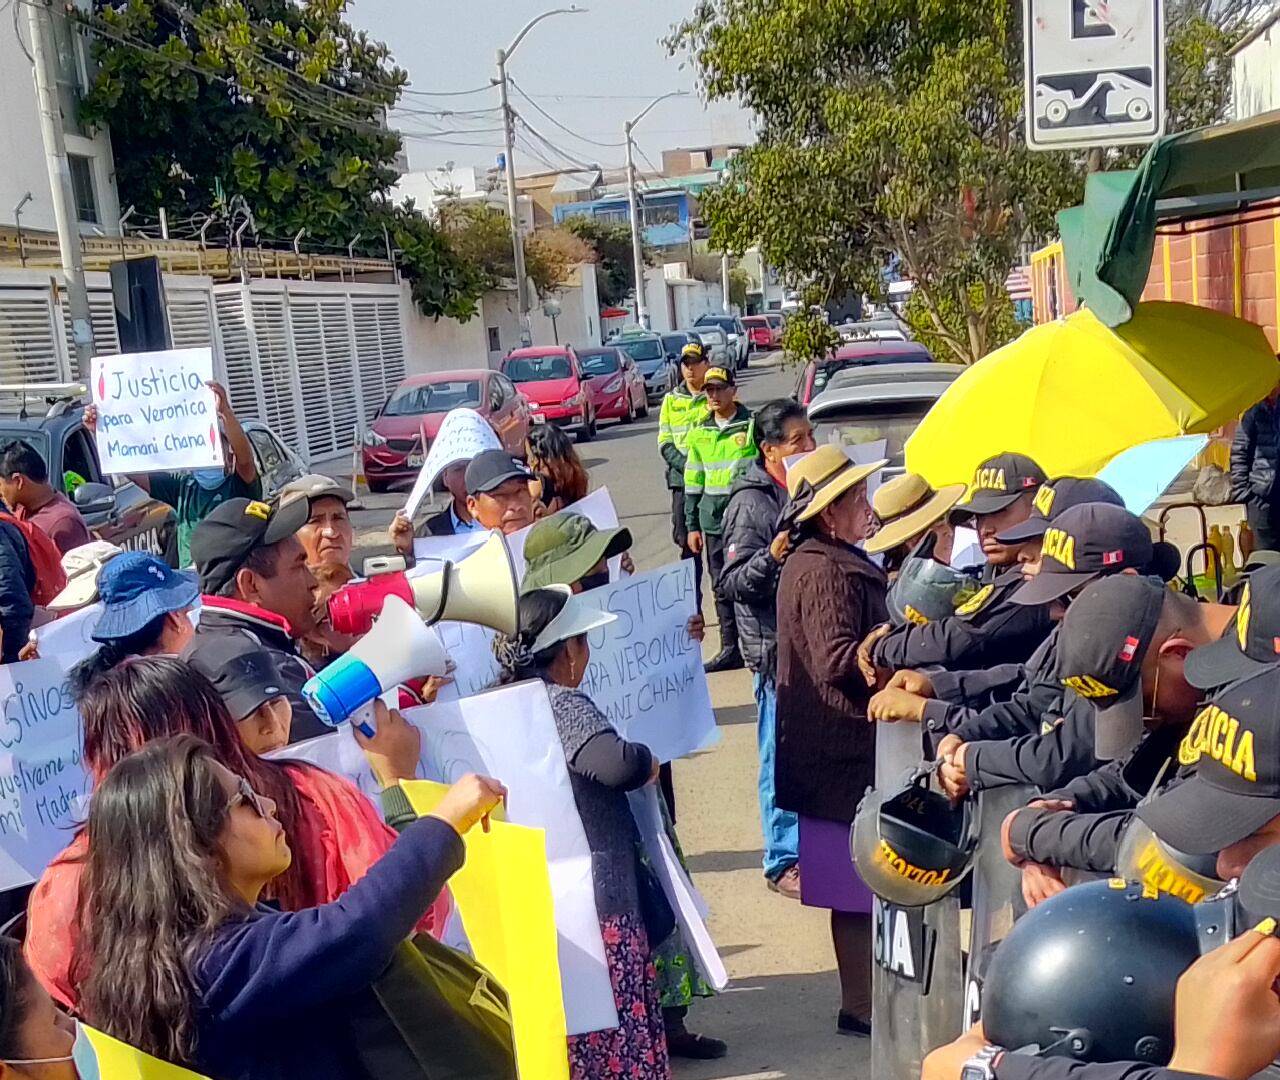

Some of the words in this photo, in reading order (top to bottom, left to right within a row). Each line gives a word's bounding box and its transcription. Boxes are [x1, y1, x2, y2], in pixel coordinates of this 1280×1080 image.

[103, 413, 133, 433] para
[140, 399, 207, 424] Veronica
[107, 437, 159, 457] Mamani
[586, 565, 694, 650] USTICIA
